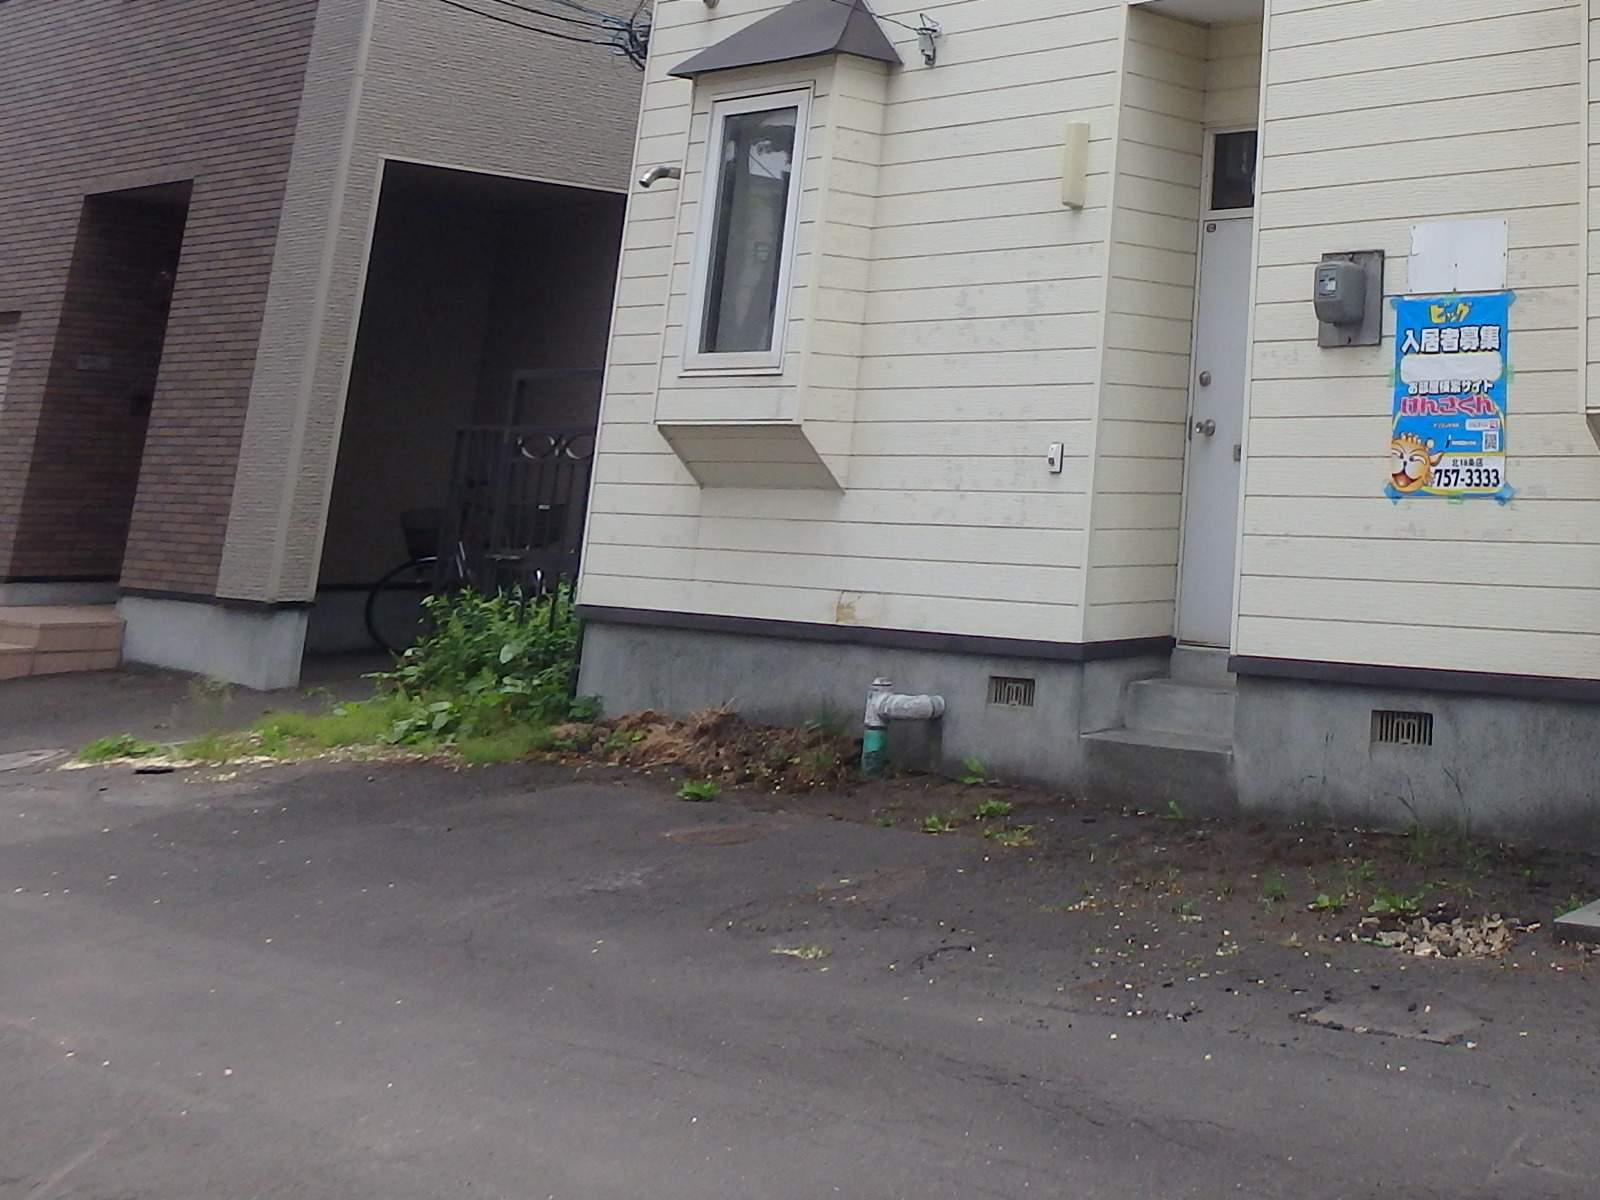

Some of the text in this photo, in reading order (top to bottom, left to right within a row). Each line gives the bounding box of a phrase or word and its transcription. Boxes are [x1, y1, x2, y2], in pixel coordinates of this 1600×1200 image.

[1401, 327, 1500, 353] 入居者募集
[1434, 469, 1500, 488] 757-3333
